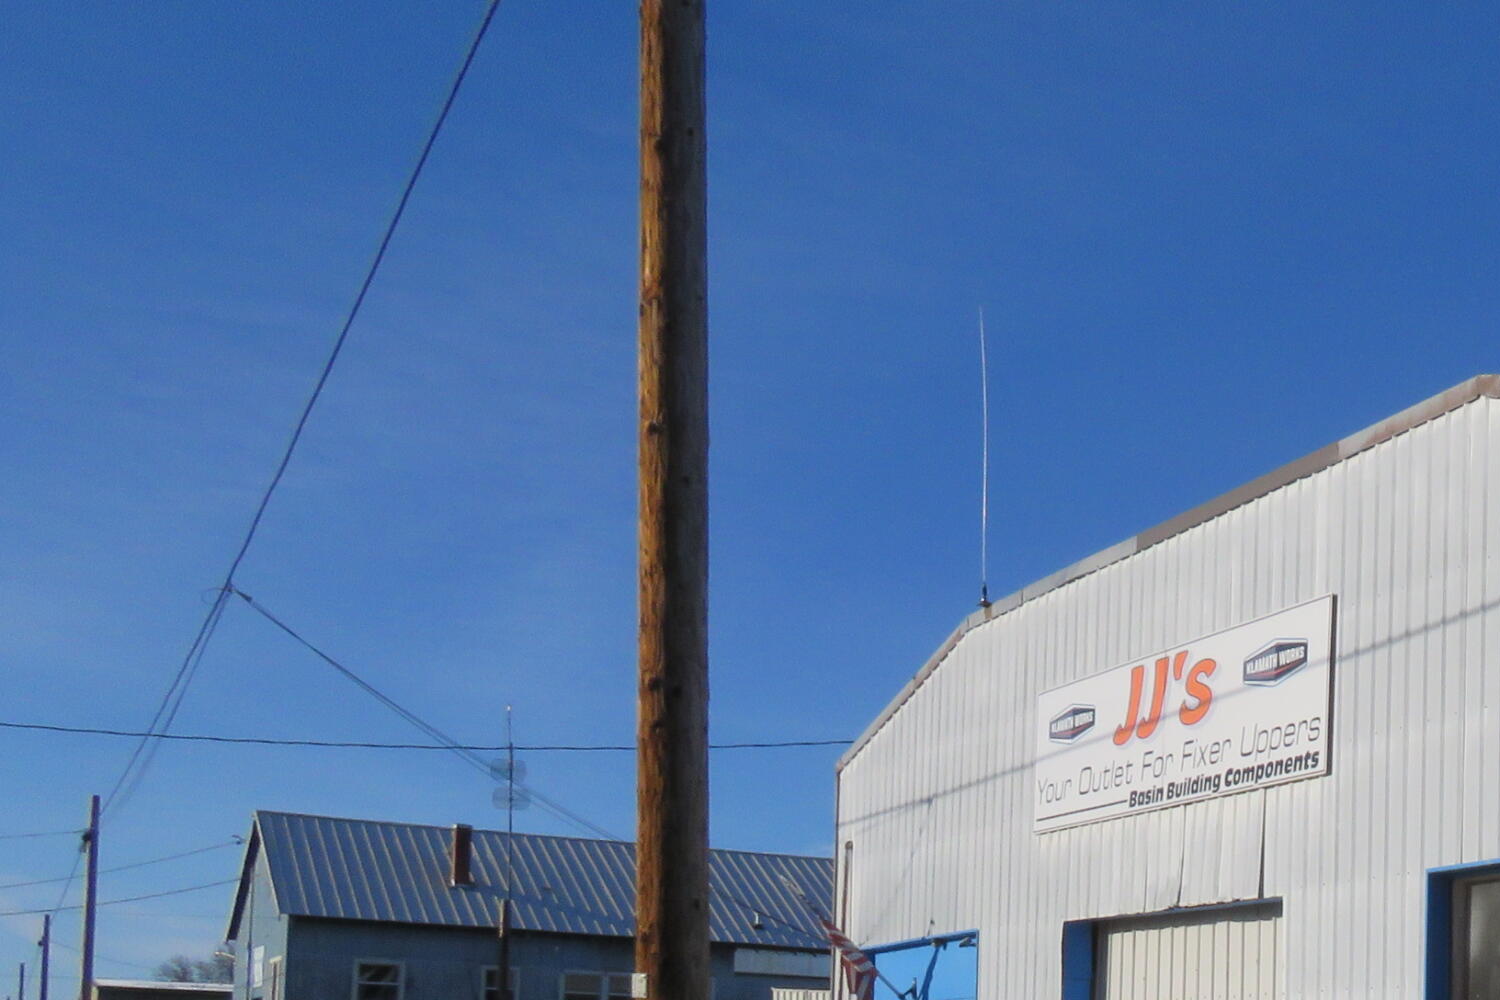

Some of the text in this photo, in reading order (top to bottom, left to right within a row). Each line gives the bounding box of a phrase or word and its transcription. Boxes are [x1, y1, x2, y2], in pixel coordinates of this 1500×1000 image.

[1113, 650, 1216, 746] JJ's
[1037, 716, 1321, 805] Your Outlet For Fixer Uppers
[1129, 750, 1320, 808] Basin Building Components
